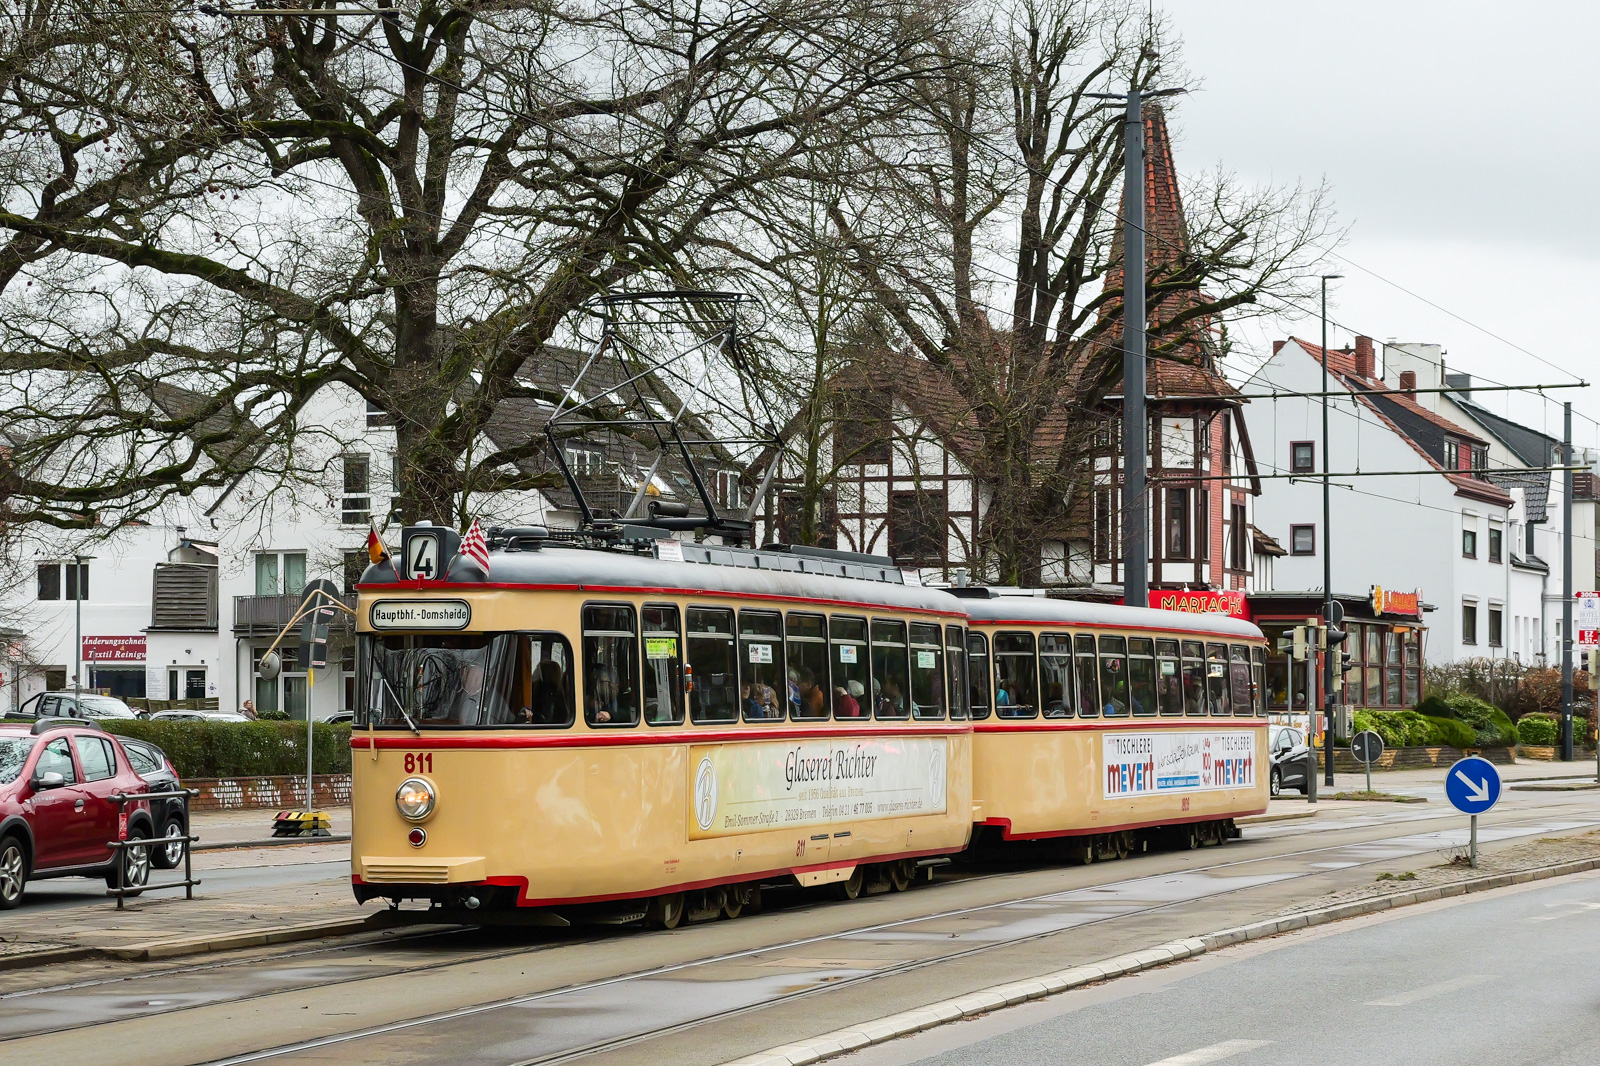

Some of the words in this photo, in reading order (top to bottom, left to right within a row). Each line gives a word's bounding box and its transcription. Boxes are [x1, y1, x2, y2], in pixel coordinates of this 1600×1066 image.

[414, 539, 433, 576] 4
[1161, 594, 1243, 615] MARIACHI
[1116, 738, 1153, 755] TISCHLEREI
[1222, 736, 1252, 751] TISCHLEREI
[403, 752, 433, 774] 811
[785, 746, 833, 791] Glaserei
[835, 744, 877, 780] Richter
[799, 808, 817, 820] Bremen
[796, 839, 806, 857] 811
